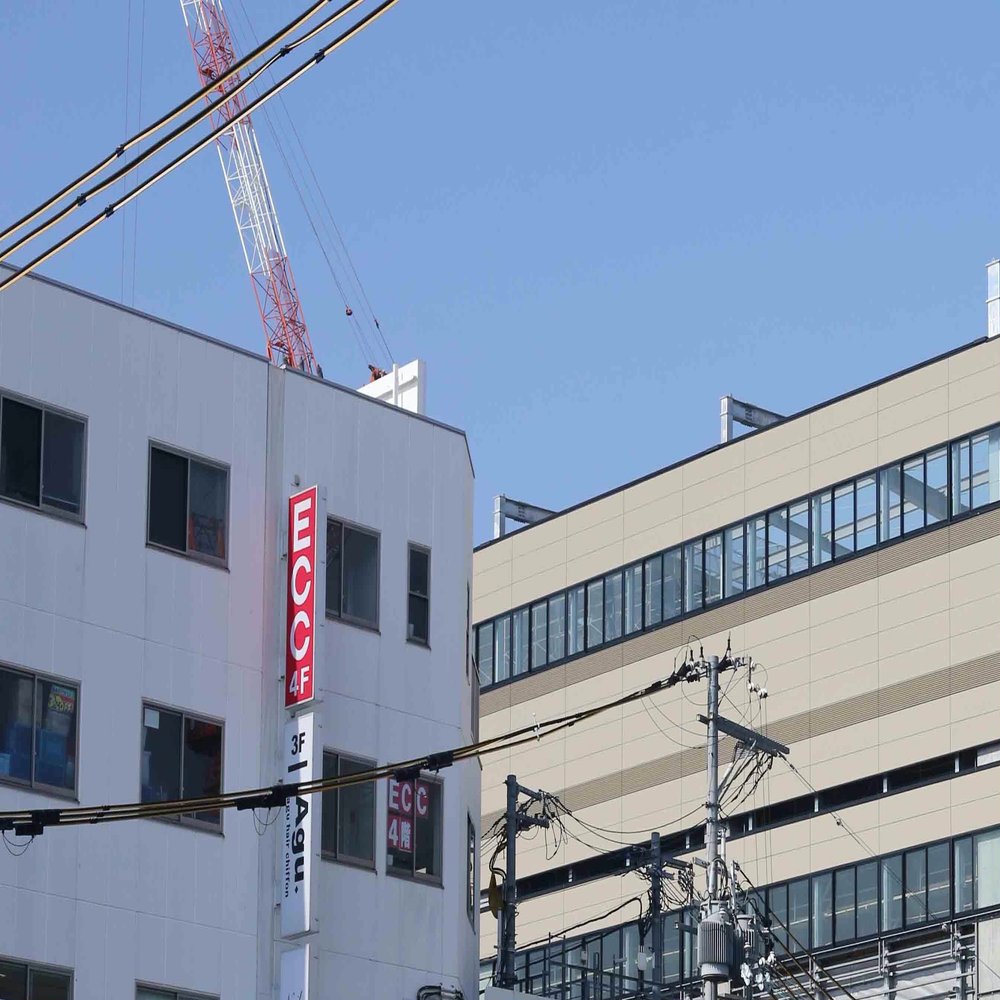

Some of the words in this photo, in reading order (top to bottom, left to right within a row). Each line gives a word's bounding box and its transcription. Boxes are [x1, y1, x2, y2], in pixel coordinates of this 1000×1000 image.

[290, 497, 312, 661] ECC
[289, 666, 310, 697] 4F
[291, 732, 306, 756] 3F
[388, 779, 428, 816] ECC
[388, 819, 412, 849] 4階
